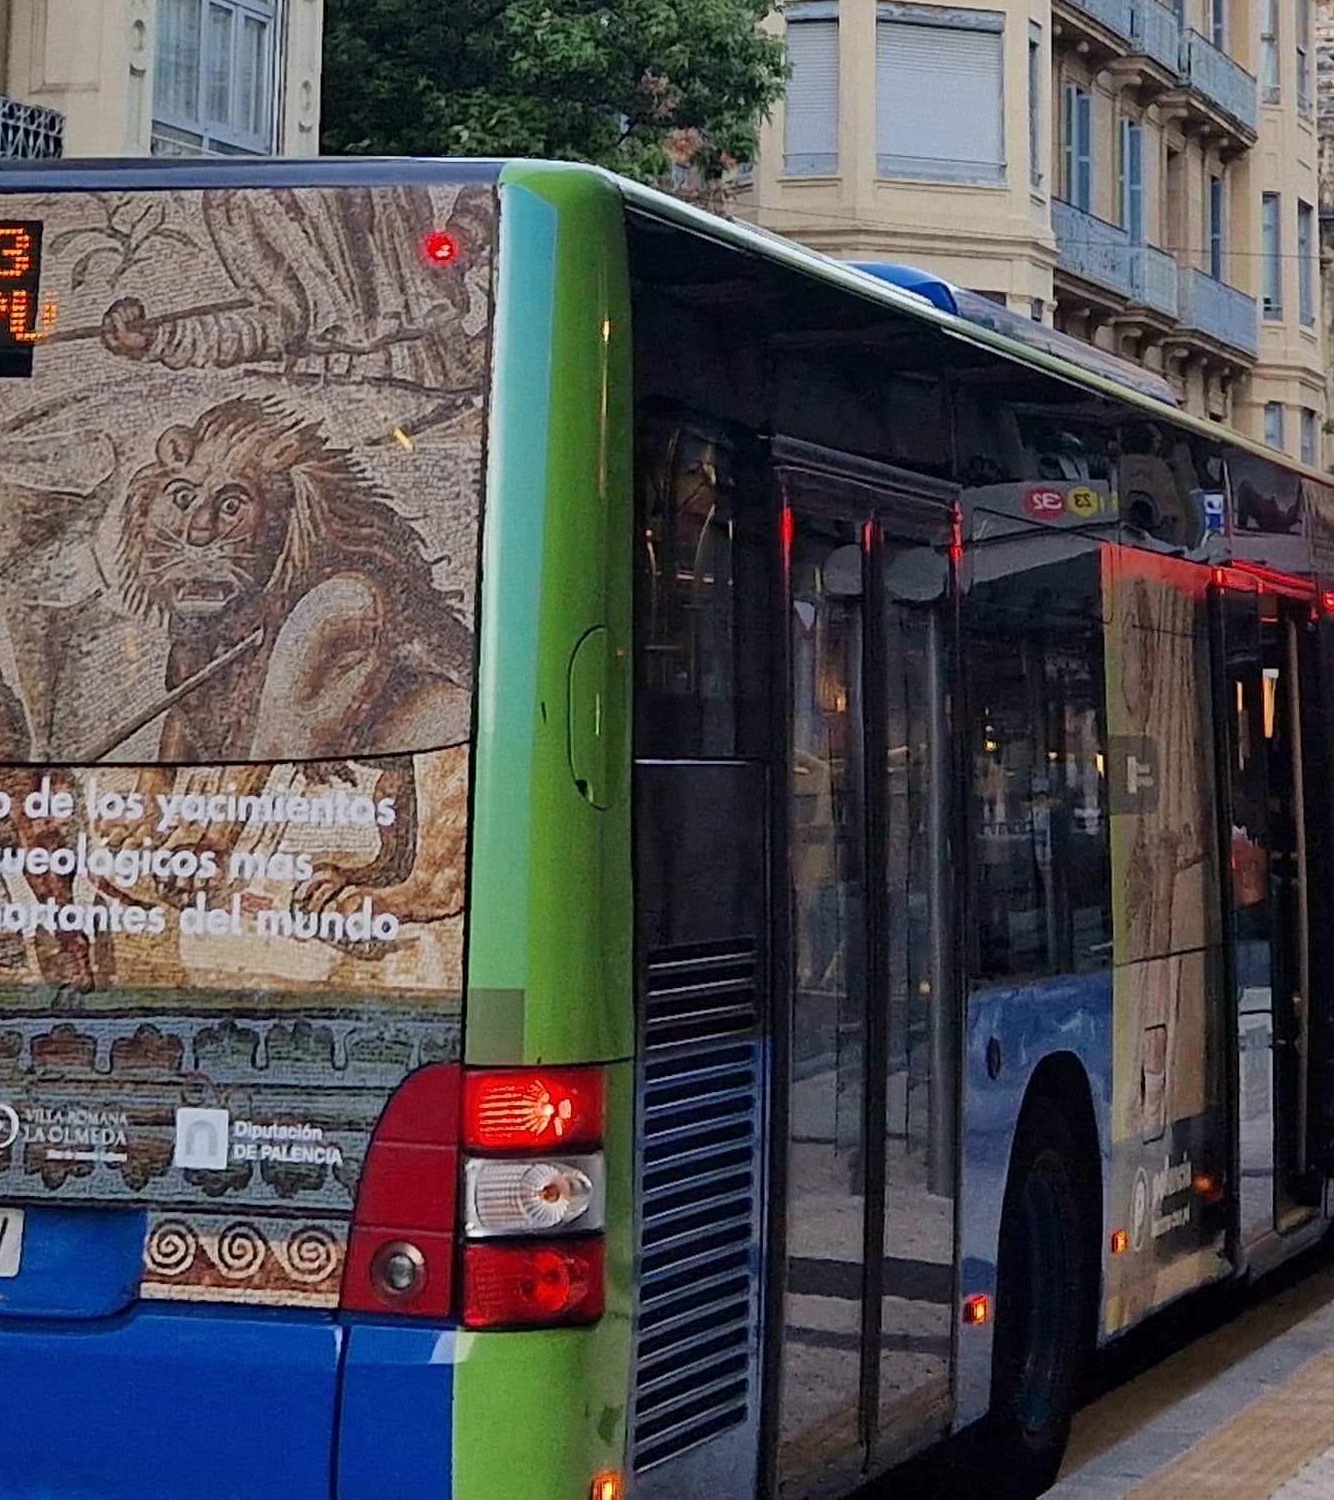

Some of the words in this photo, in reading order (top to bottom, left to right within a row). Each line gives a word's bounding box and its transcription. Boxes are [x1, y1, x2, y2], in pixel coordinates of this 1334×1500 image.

[25, 776, 75, 819] de
[87, 776, 145, 820] los
[156, 782, 397, 832] yacimientos
[179, 891, 242, 936] del
[258, 896, 400, 942] mundo
[49, 1125, 128, 1146] OLMEDA
[234, 1120, 323, 1142] Diputación
[233, 1143, 257, 1160] DE
[261, 1145, 344, 1166] PALENCIA
